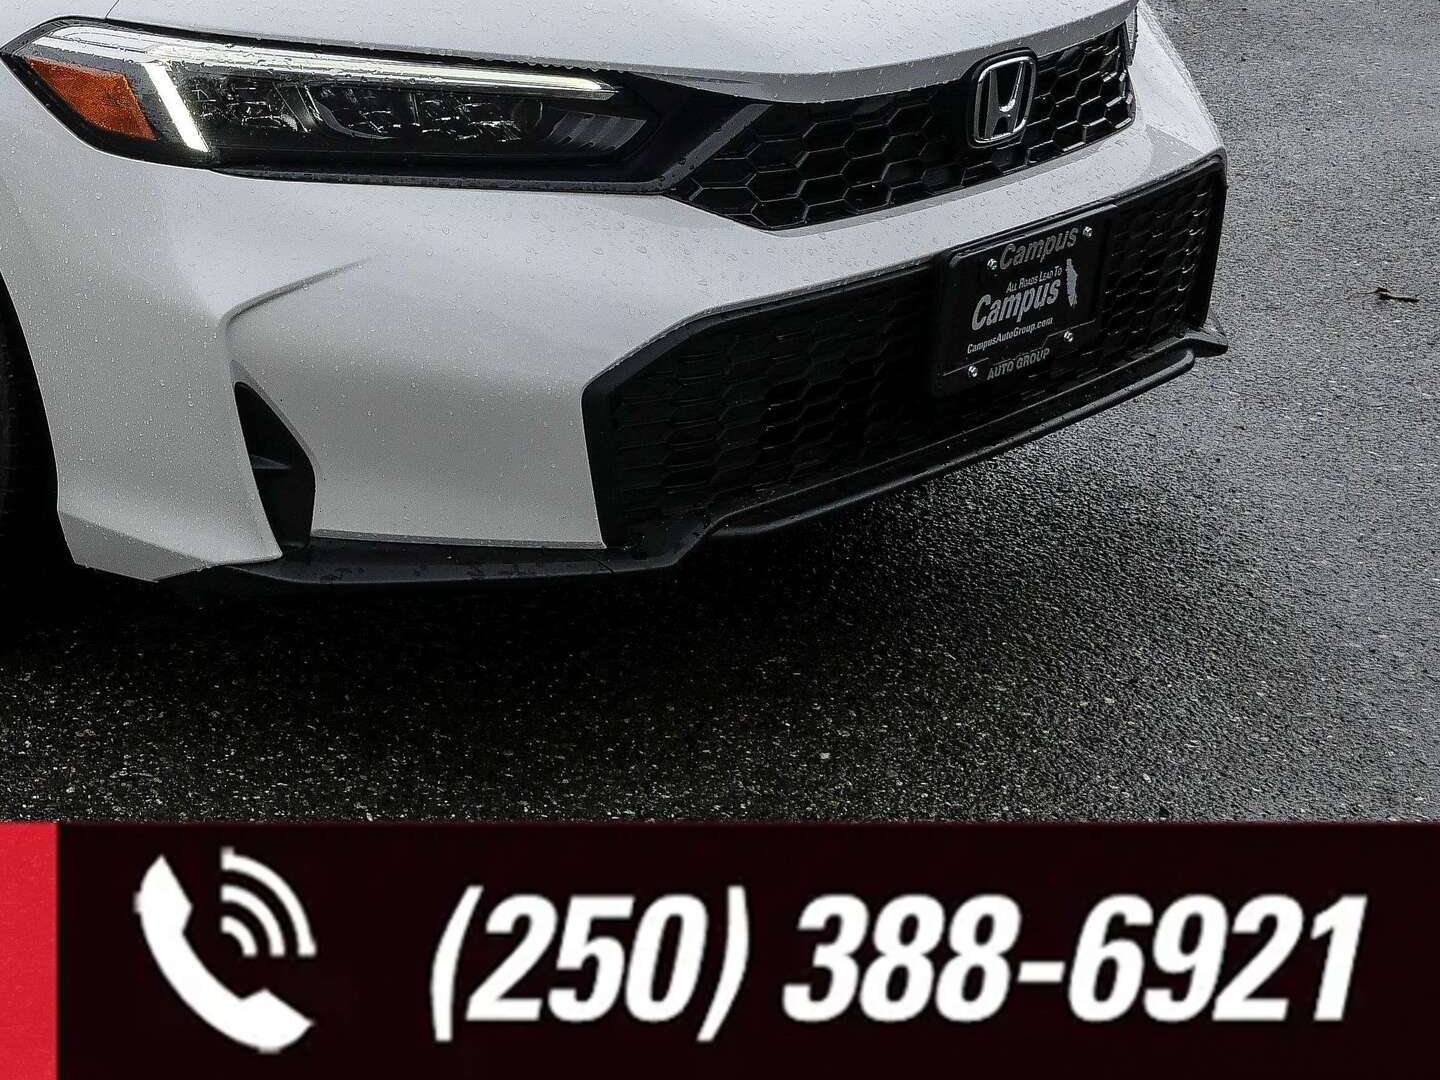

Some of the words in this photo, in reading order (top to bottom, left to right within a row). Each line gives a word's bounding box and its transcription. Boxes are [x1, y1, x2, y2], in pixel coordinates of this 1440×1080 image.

[999, 227, 1079, 270] Campus
[971, 278, 1061, 331] Campus
[967, 317, 1054, 354] CampusAutoGroup.com
[986, 358, 1015, 381] AUTO
[1016, 347, 1051, 370] GROUP
